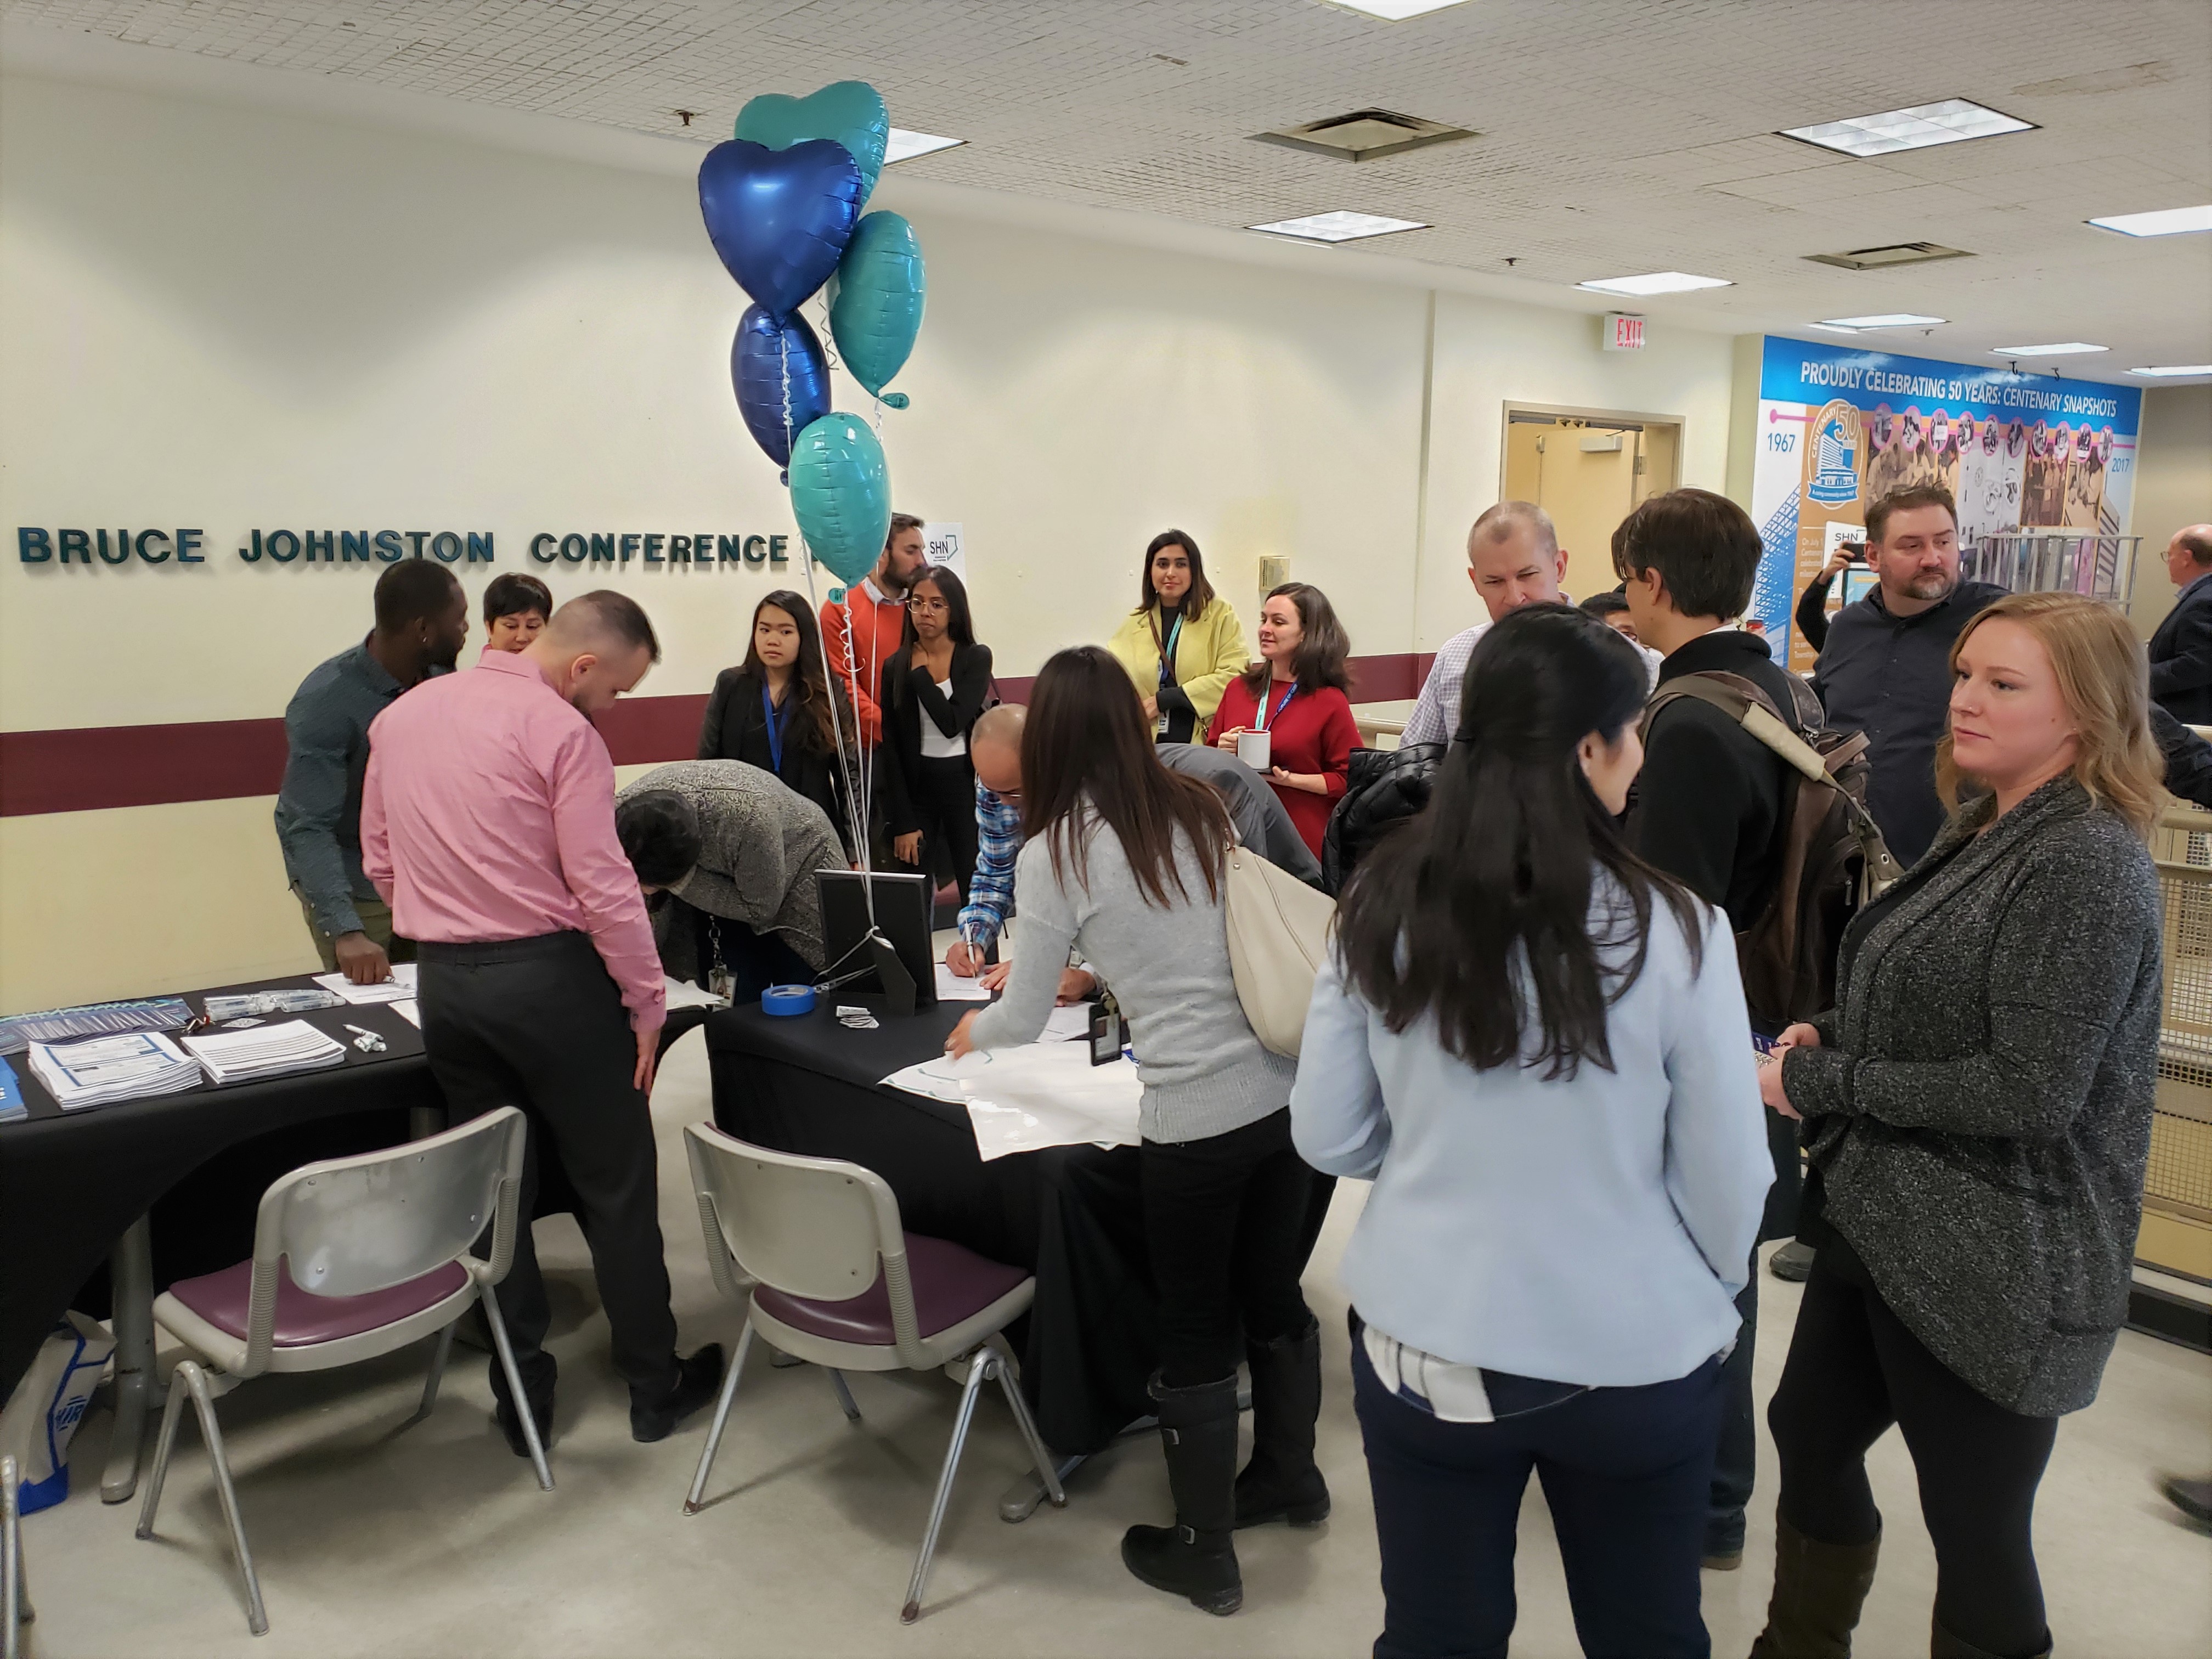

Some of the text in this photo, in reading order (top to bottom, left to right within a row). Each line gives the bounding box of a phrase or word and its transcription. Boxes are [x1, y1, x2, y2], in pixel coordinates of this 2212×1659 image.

[1617, 319, 1643, 348] EXIT
[1801, 362, 2117, 417] PROUDLY CELEBRATING 50 YEARS: CENTENARY SNAPSHOTS
[1812, 406, 1837, 458] CENTENARY
[1834, 404, 1860, 441] 50
[1768, 433, 1795, 453] 1967
[2112, 458, 2130, 472] 2017
[18, 527, 789, 564] BRUCE JOHNSTON CONFERENCE
[930, 541, 948, 554] SHN
[1835, 533, 1858, 541] SHN
